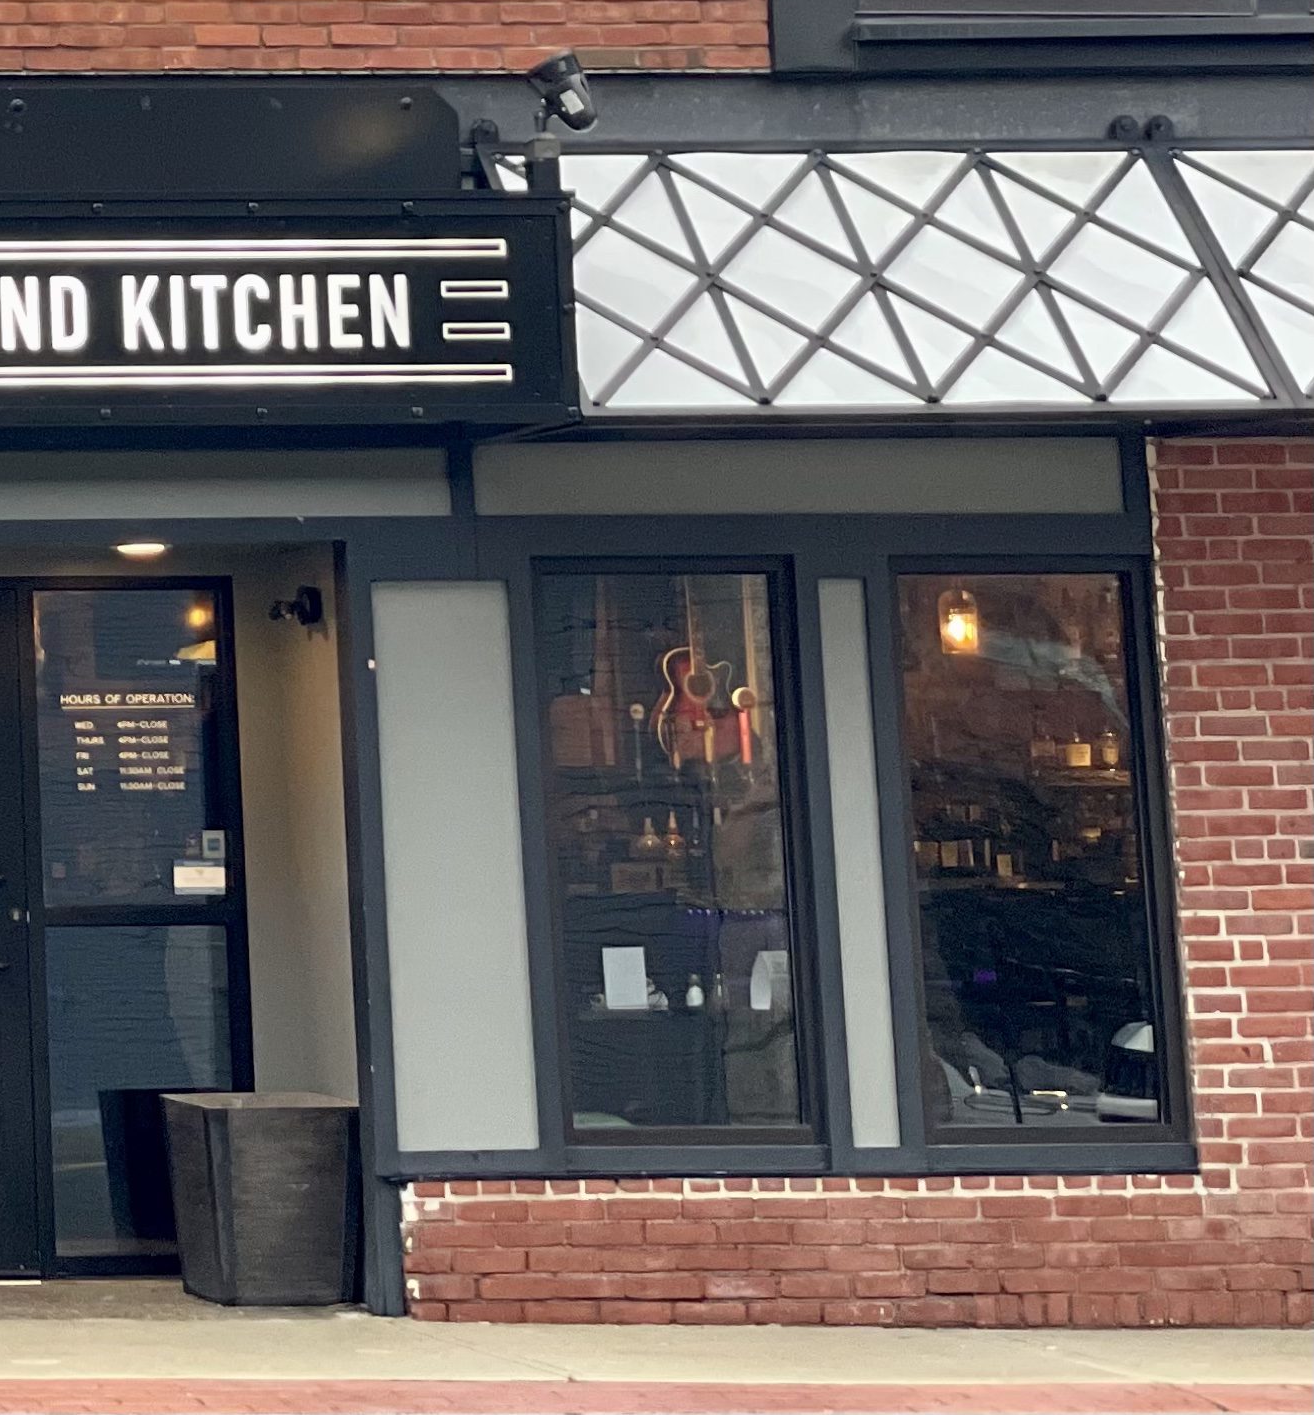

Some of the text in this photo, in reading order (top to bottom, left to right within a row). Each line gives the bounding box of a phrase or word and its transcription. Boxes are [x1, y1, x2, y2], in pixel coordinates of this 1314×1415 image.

[121, 273, 411, 351] KITCHEN
[60, 694, 101, 704] HOURS
[105, 694, 121, 704] OF
[76, 767, 94, 776] SAT
